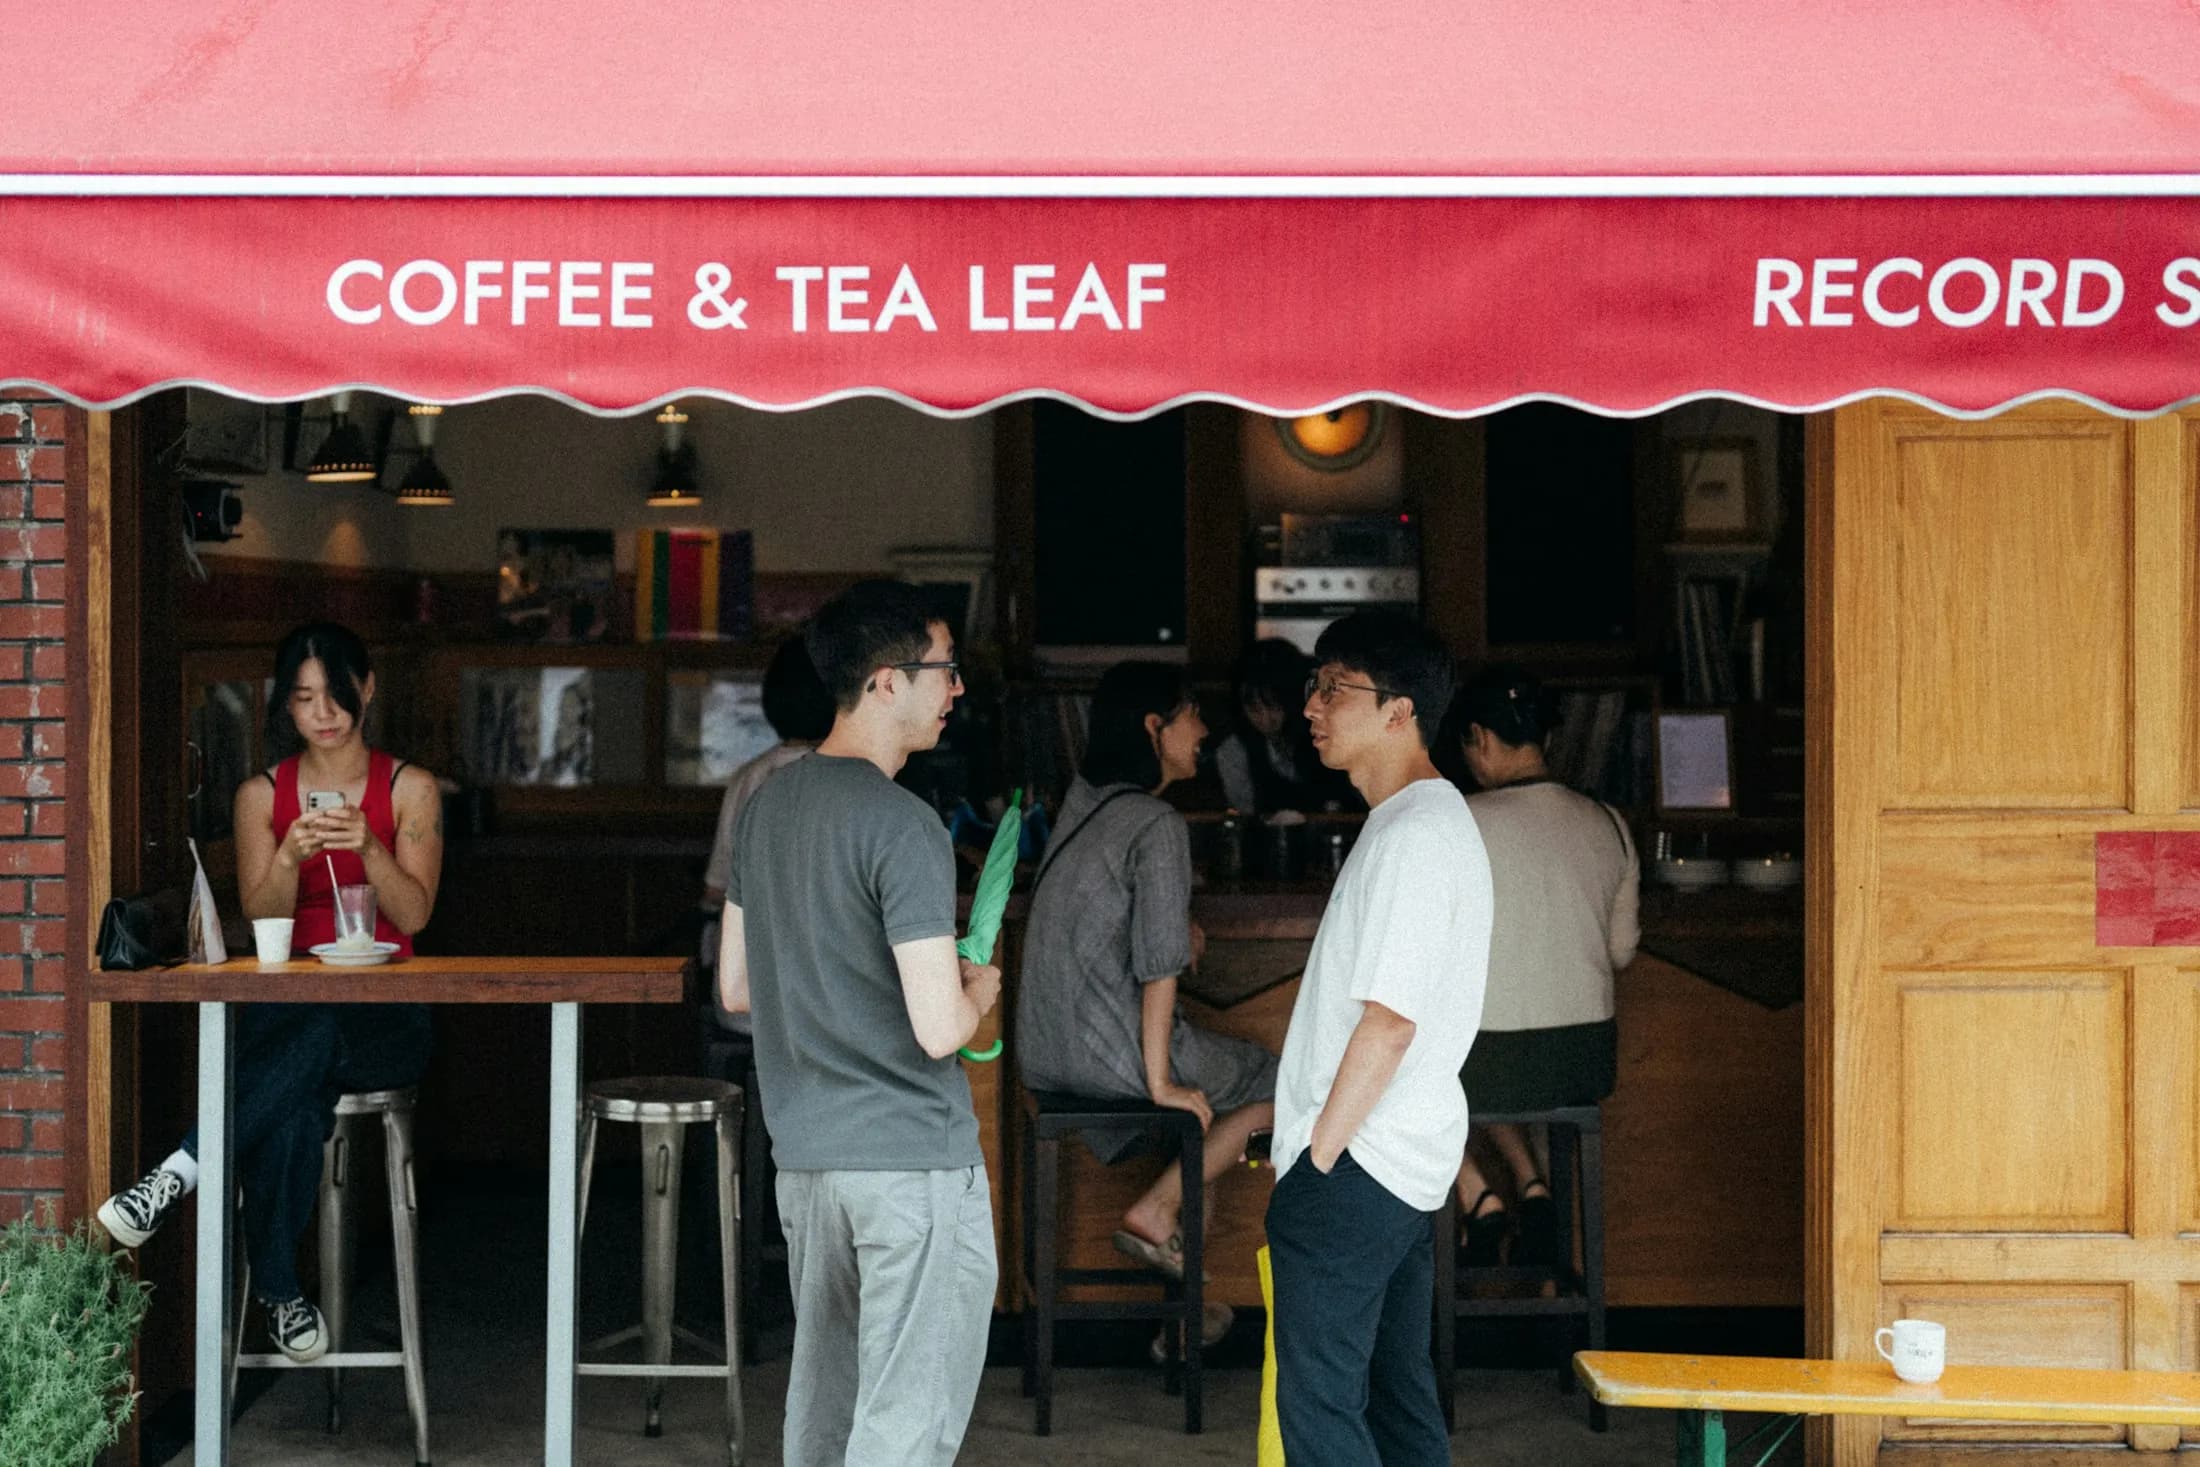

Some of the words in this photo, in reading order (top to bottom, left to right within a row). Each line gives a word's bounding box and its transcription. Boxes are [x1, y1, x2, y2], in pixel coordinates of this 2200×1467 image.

[325, 258, 655, 328] COFFEE
[686, 261, 749, 331] &
[775, 265, 938, 333] TEA
[969, 263, 1167, 332] LEAF
[1753, 257, 2124, 328] RECORD
